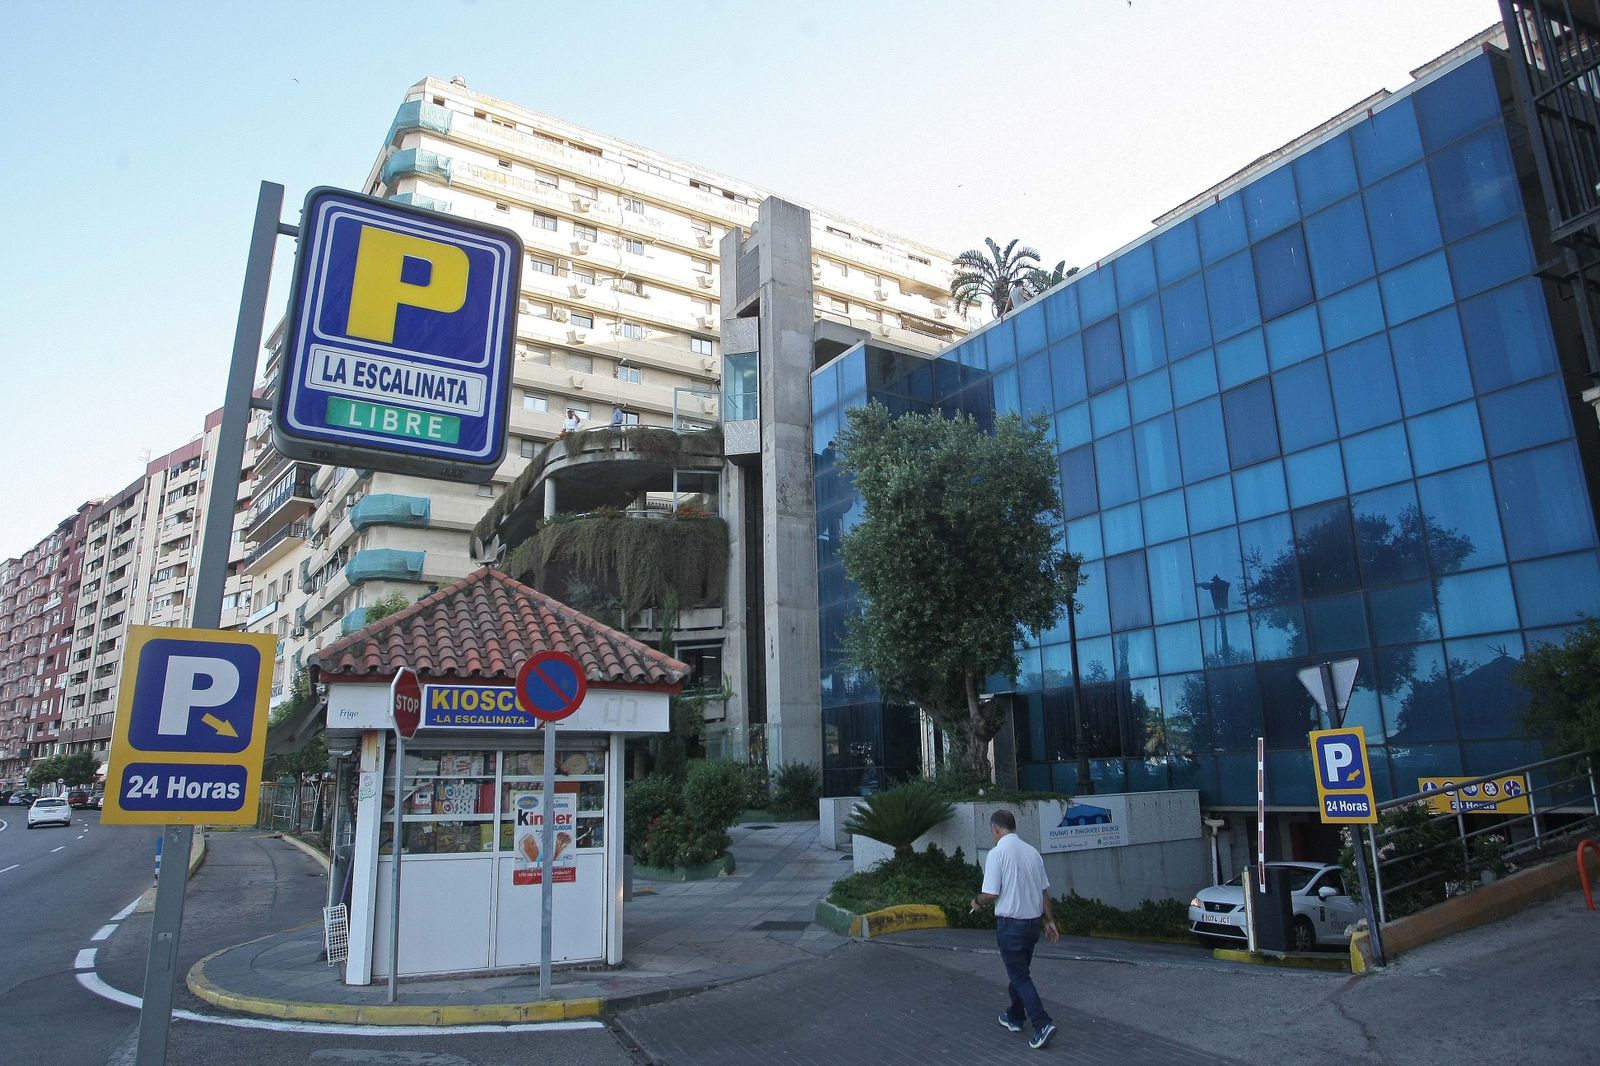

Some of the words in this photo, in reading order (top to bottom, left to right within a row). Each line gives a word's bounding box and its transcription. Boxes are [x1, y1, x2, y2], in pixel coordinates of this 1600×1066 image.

[346, 225, 470, 344] P
[321, 355, 346, 384] LA
[353, 361, 468, 405] ESCALINATA
[349, 403, 443, 438] LIBRE
[158, 655, 240, 736] P
[395, 693, 419, 714] STOP
[340, 709, 359, 720] Frigo
[1323, 743, 1353, 782] P
[126, 775, 159, 799] 24
[166, 776, 240, 799] Horas
[518, 808, 573, 826] Kiner
[1326, 800, 1338, 812] 24
[1339, 800, 1368, 812] Horas
[1451, 801, 1463, 809] 2
